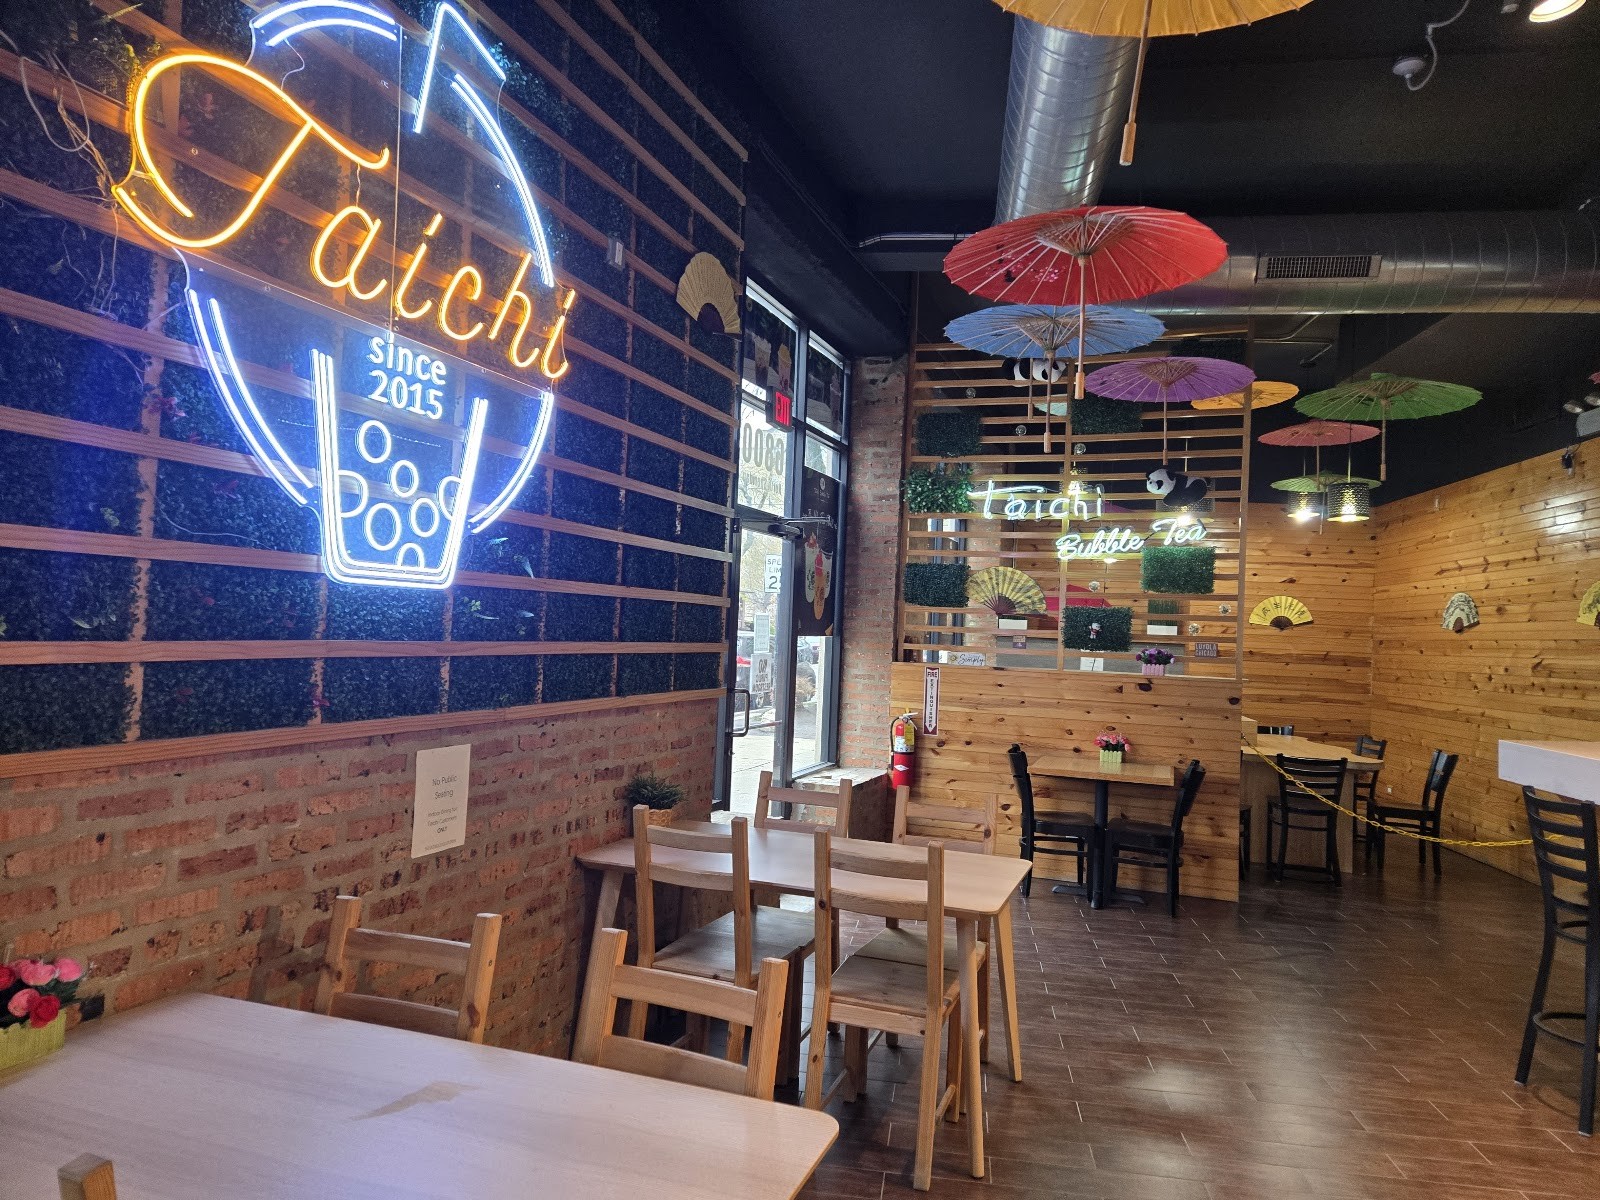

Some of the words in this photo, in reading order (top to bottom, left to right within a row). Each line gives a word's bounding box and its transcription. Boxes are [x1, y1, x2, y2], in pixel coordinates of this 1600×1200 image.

[113, 54, 577, 379] Taichi
[367, 330, 447, 385] since
[367, 370, 444, 420] 2015
[969, 480, 1103, 521] Taichi
[1055, 529, 1145, 561] Bubble
[1151, 517, 1208, 546] Tea
[767, 558, 782, 566] SPE
[768, 575, 781, 590] 2
[432, 778, 441, 786] No
[441, 775, 458, 784] Public
[434, 789, 454, 800] Seating
